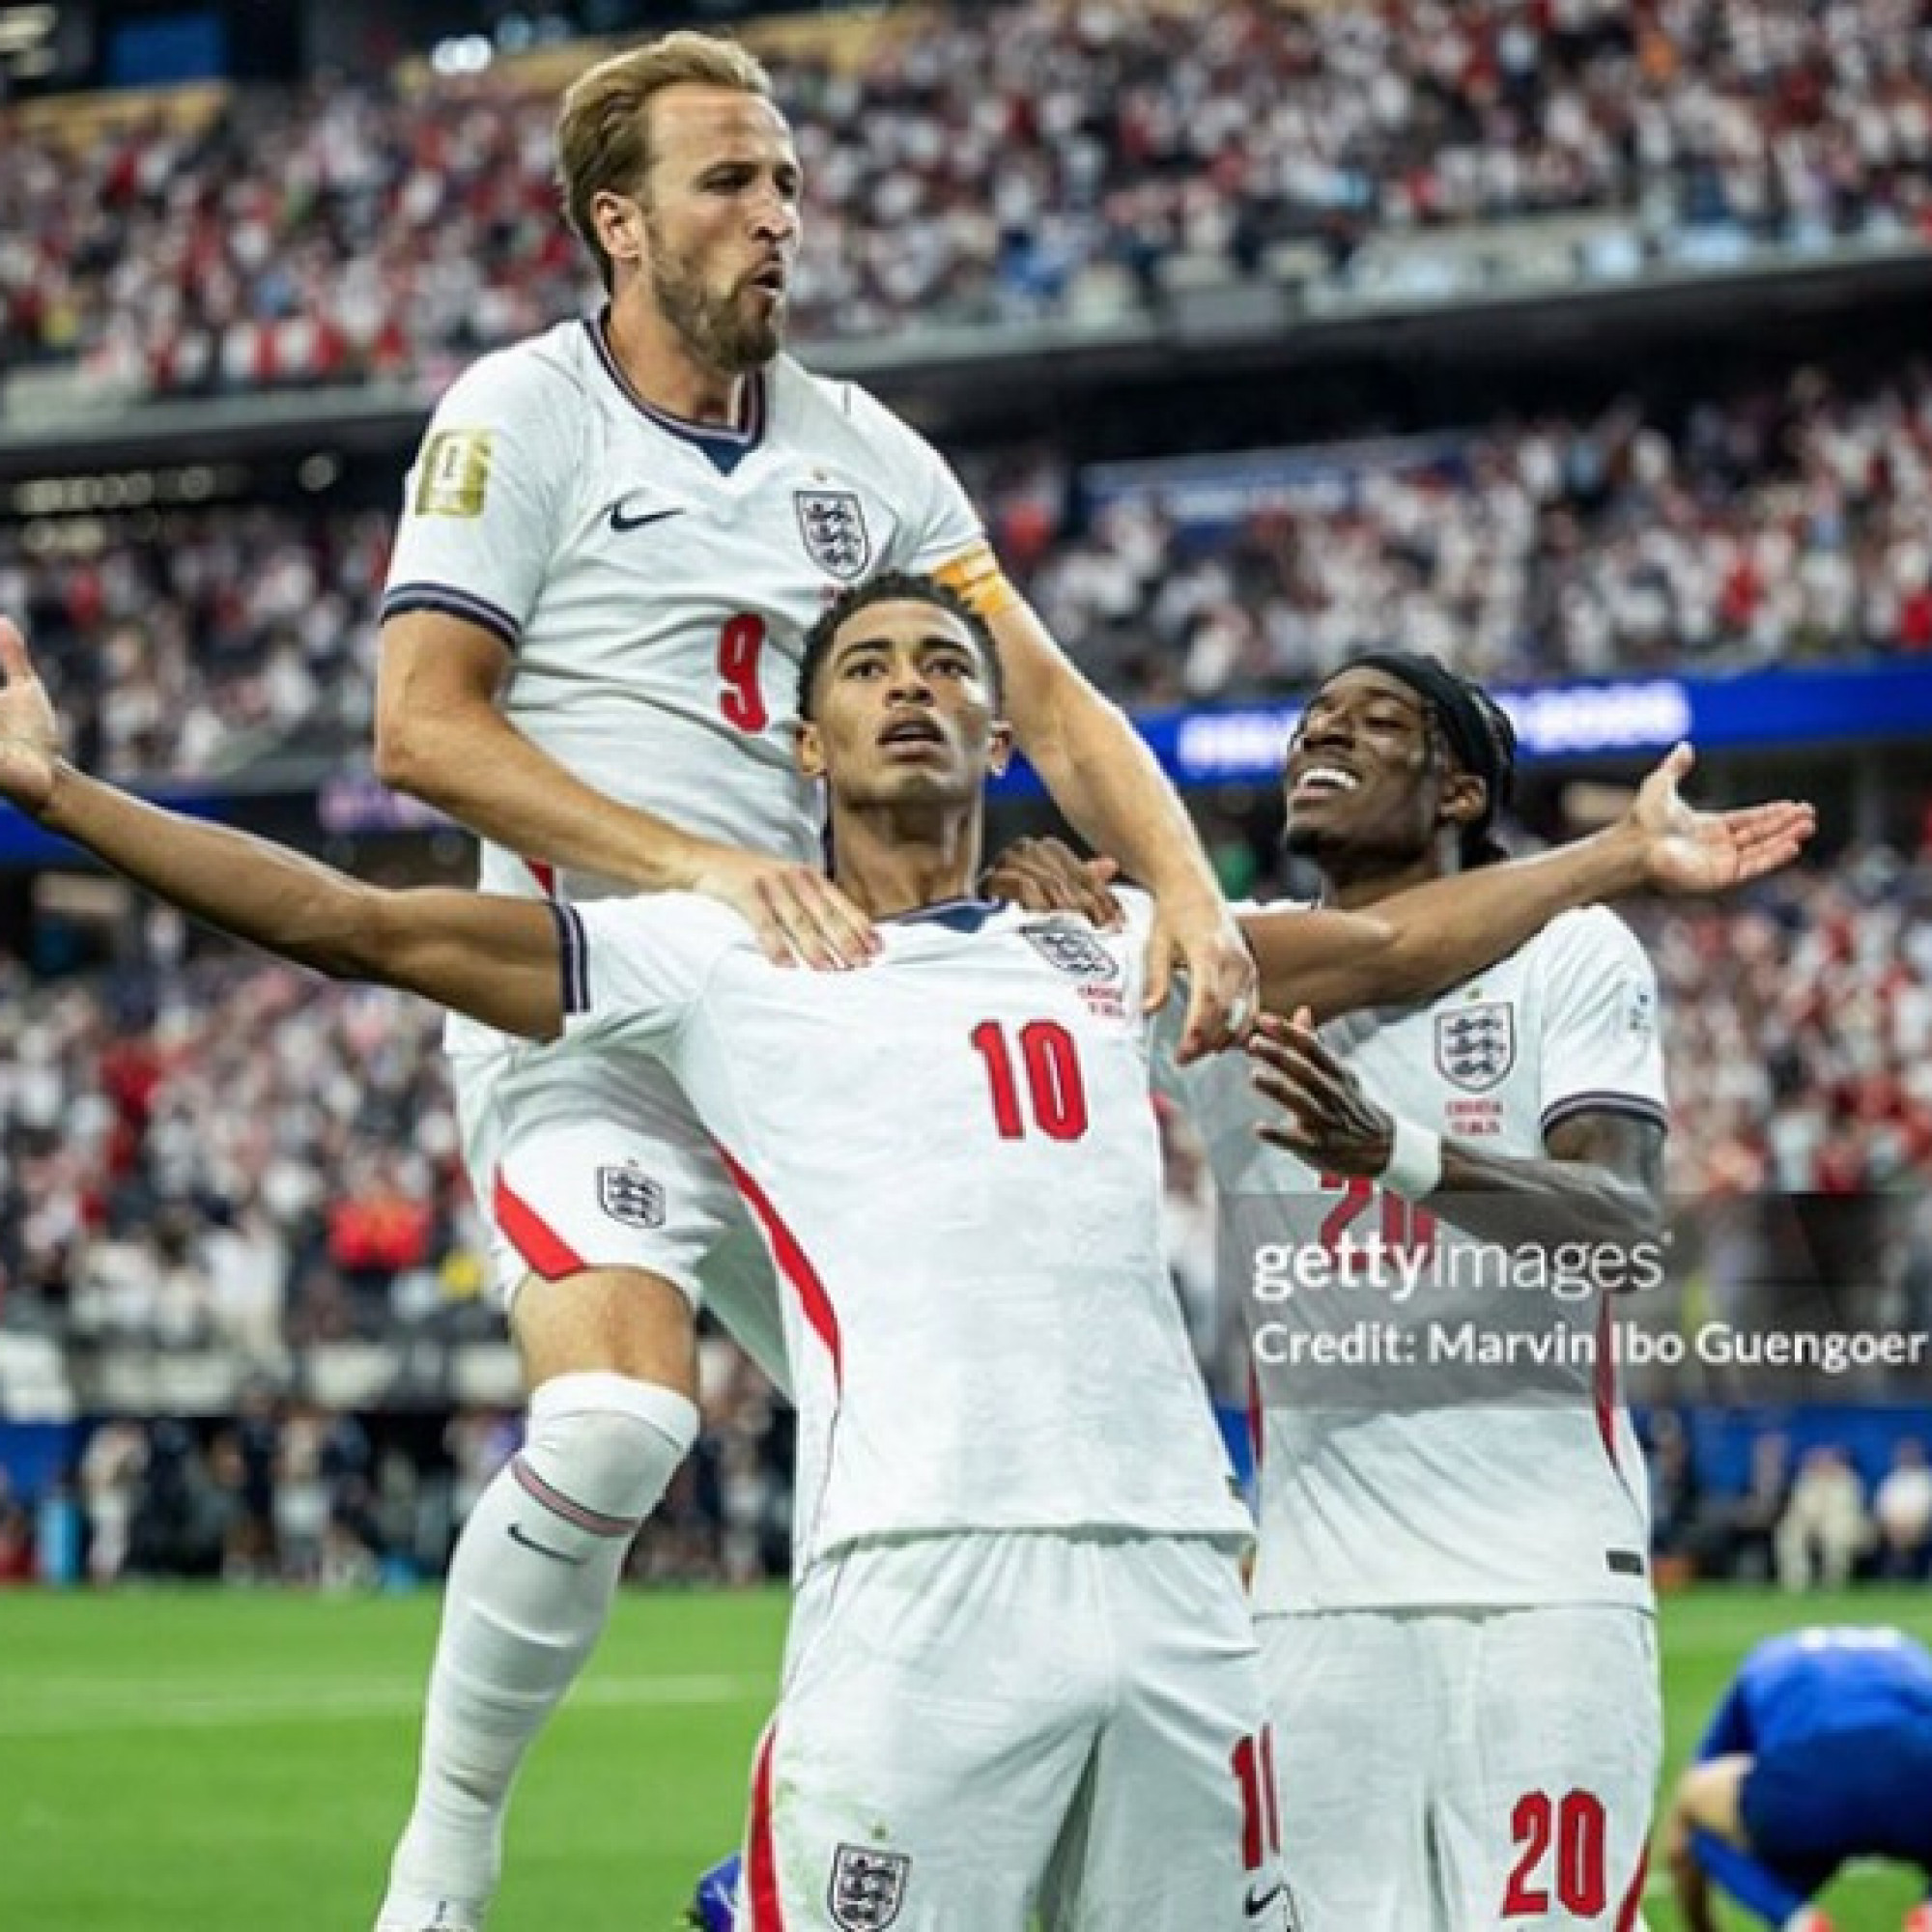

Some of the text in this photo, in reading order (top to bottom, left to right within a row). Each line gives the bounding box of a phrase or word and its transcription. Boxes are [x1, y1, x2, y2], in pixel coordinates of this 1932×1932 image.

[717, 611, 769, 734] 9
[969, 1019, 1089, 1142] 10
[1502, 1789, 1606, 1918] 20
